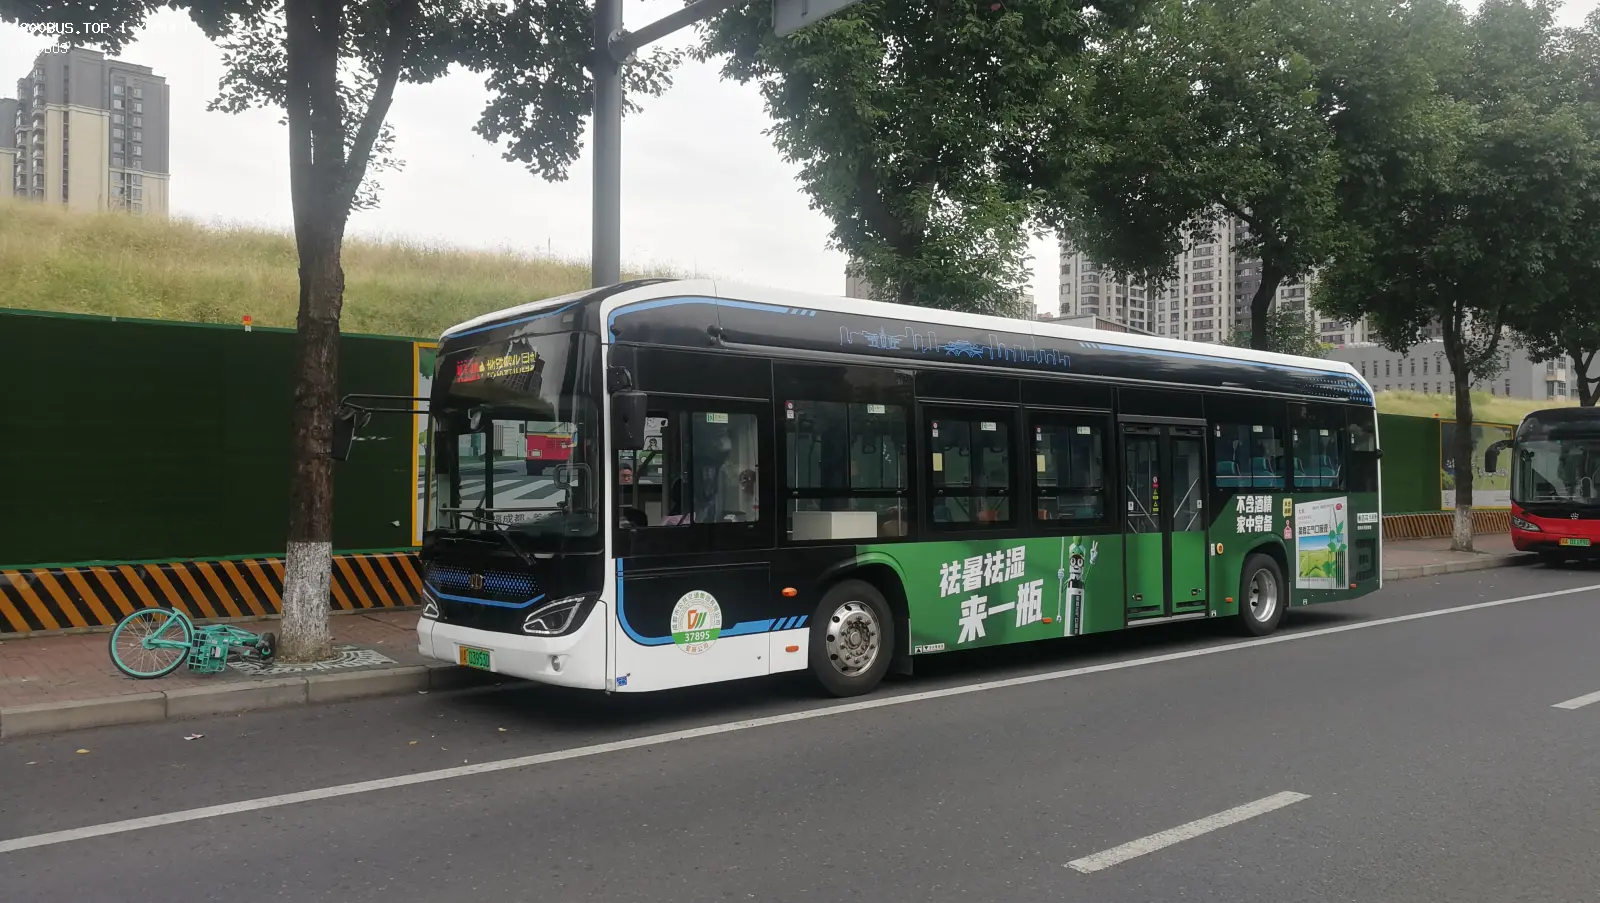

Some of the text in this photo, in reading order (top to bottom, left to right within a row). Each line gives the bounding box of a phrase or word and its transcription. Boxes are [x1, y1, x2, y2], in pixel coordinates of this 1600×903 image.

[1236, 495, 1272, 513] 不含酒精
[1236, 514, 1272, 533] 家中常备
[939, 545, 1026, 598] 祛暑祛湿
[957, 578, 1044, 644] 来一瓶
[684, 630, 711, 642] 37895
